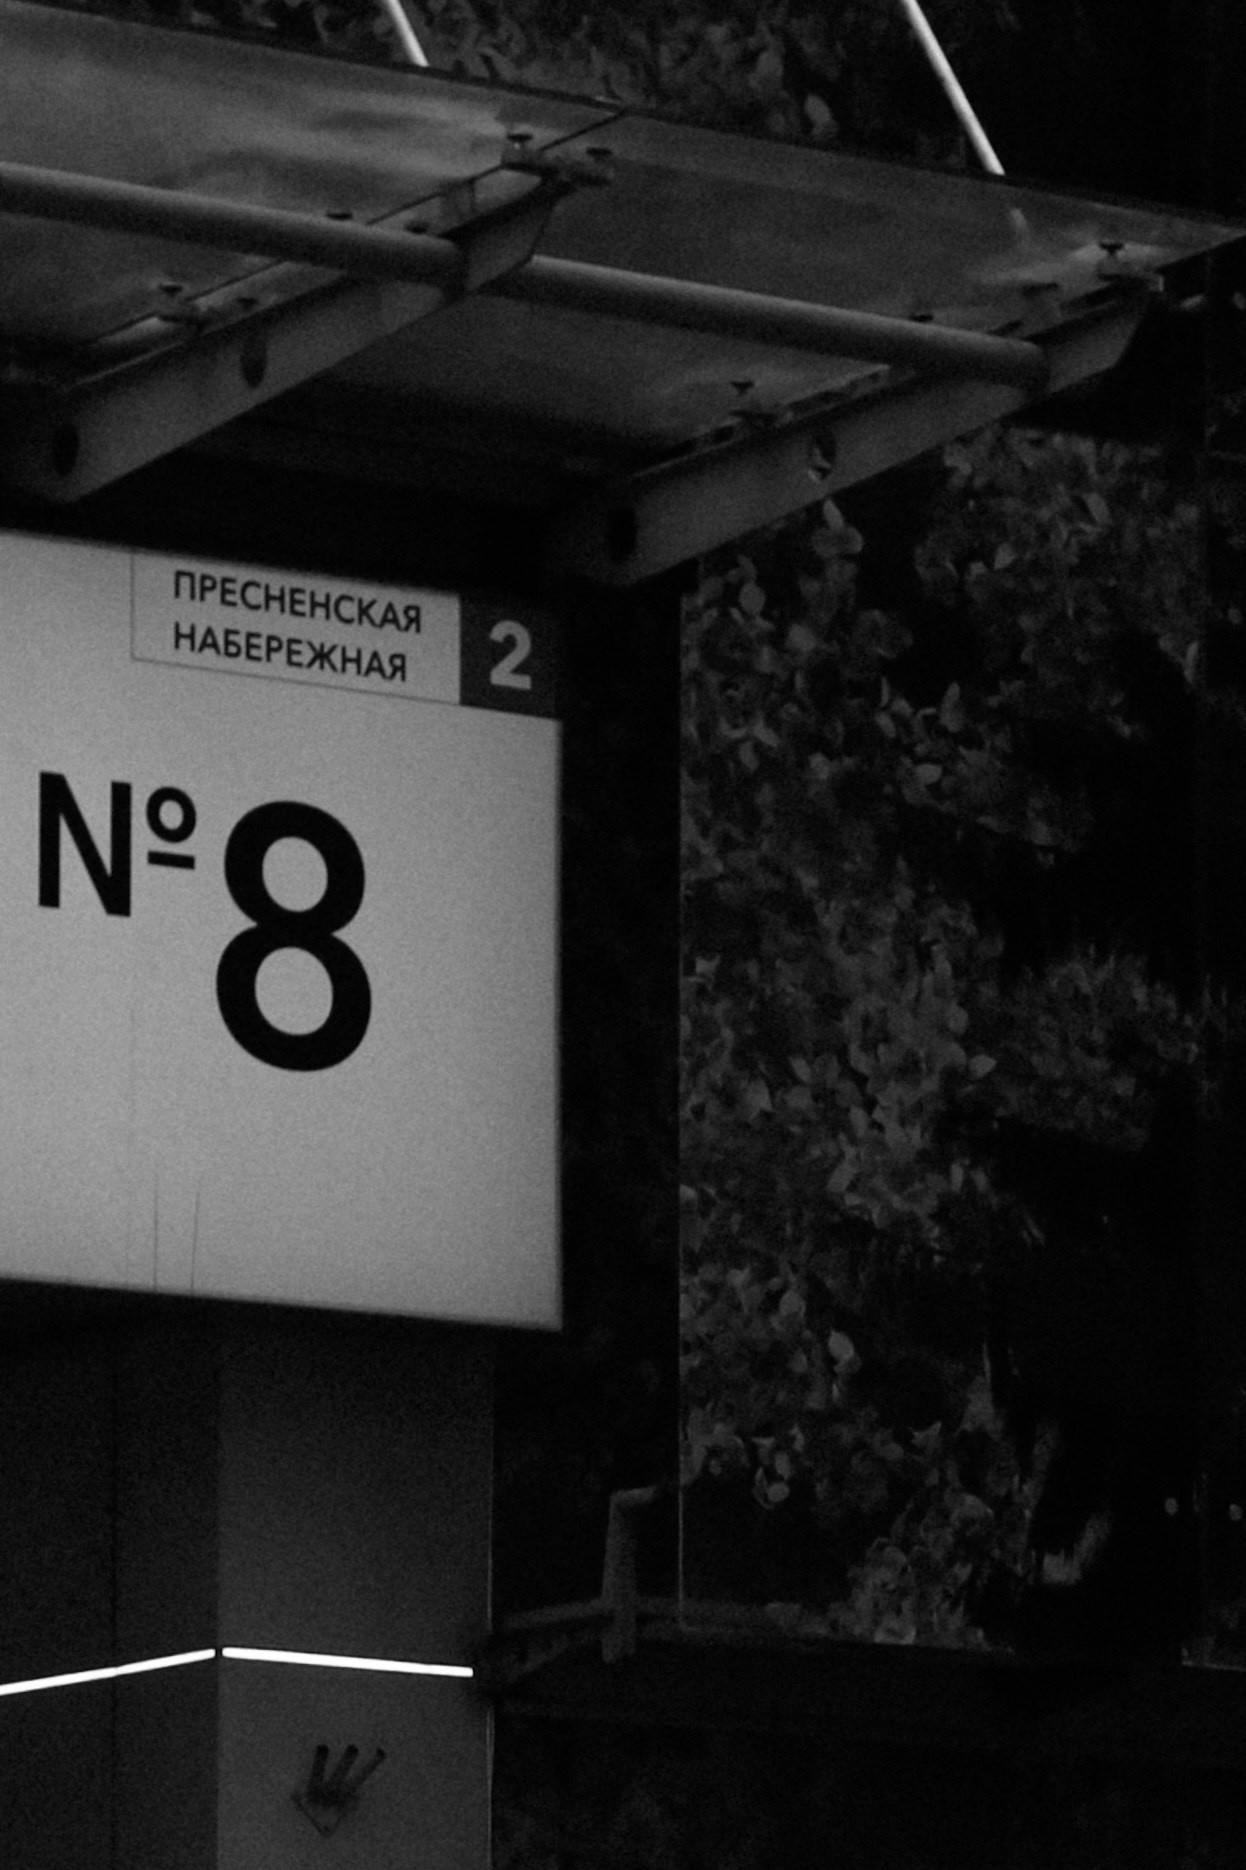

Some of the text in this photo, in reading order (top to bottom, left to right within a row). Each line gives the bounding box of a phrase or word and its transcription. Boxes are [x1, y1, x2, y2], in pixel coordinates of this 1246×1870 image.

[173, 569, 422, 634] ПРЕСНЕНСКАЯ
[174, 621, 407, 683] НАБЕРЕЖНАЯ
[488, 619, 533, 691] 2
